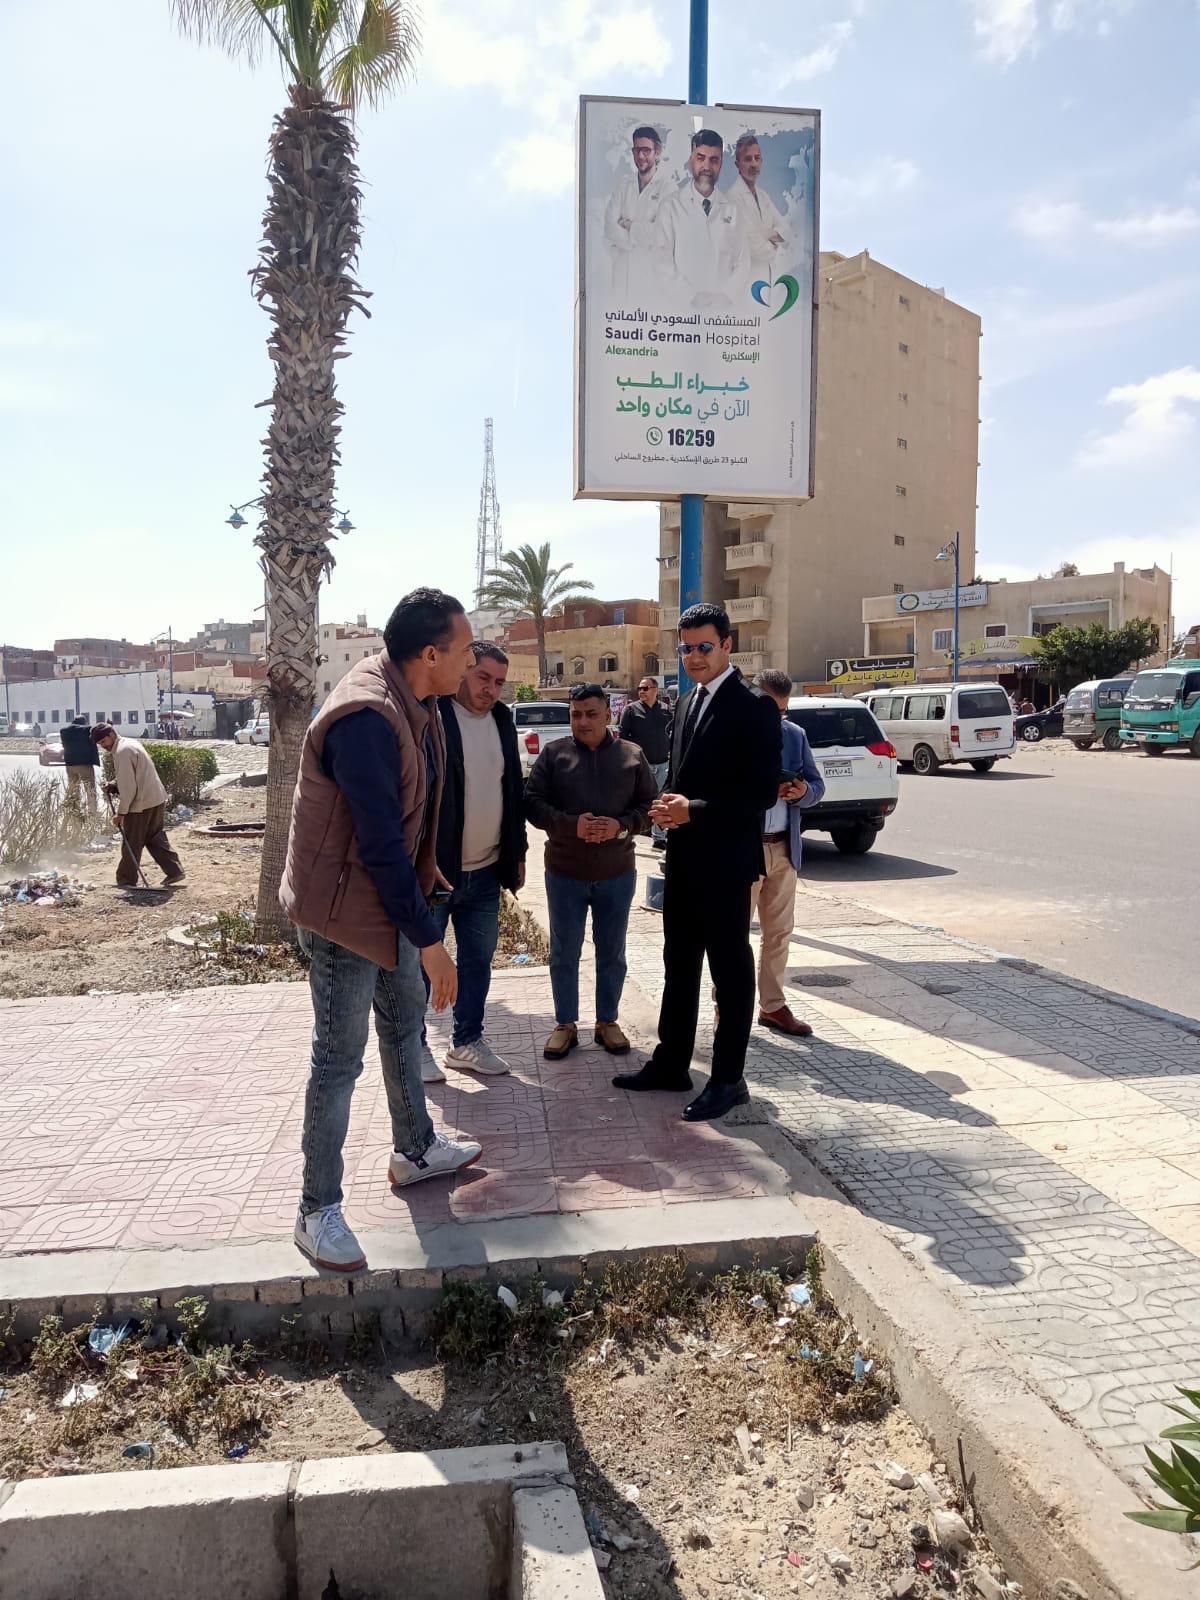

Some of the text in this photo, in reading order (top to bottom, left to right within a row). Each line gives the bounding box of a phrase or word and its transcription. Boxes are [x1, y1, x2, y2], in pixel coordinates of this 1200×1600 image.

[605, 308, 761, 327] المستشفى السعودي الألماني
[605, 327, 760, 347] Saudi German Hospital
[605, 345, 659, 357] Alexandria
[722, 351, 760, 363] الإسكندرية
[616, 371, 750, 396] خبراء الطب
[616, 396, 750, 424] الآن في مكان واحد
[667, 428, 715, 447] 16259
[642, 454, 665, 463] مطروح
[670, 455, 702, 465] الإسكندرية
[703, 456, 720, 465] طريق
[721, 456, 729, 464] 23
[730, 456, 748, 466] الكيلو
[852, 658, 910, 671] صيدلية
[853, 672, 873, 681] عابد
